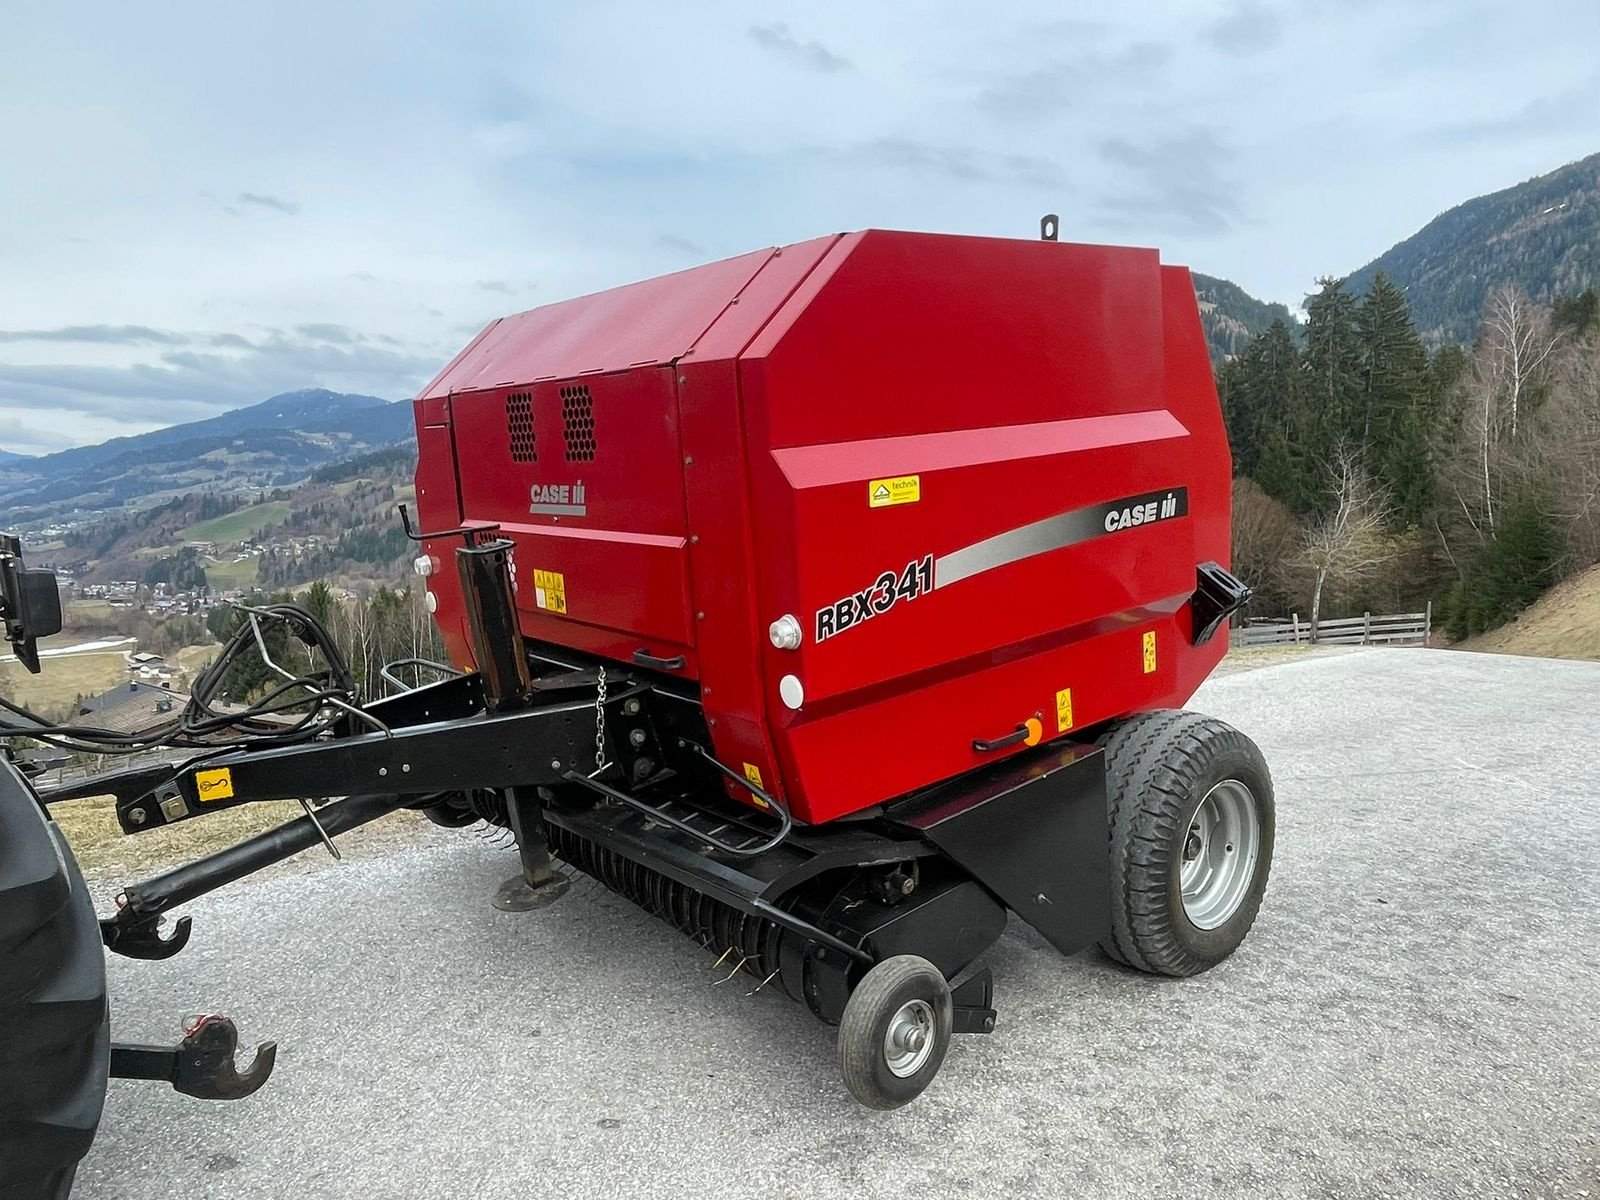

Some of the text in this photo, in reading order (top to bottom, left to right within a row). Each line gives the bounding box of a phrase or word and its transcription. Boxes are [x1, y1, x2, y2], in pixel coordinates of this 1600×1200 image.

[530, 484, 570, 504] CASE
[1104, 502, 1158, 532] CASE
[815, 553, 934, 645] RBX341
